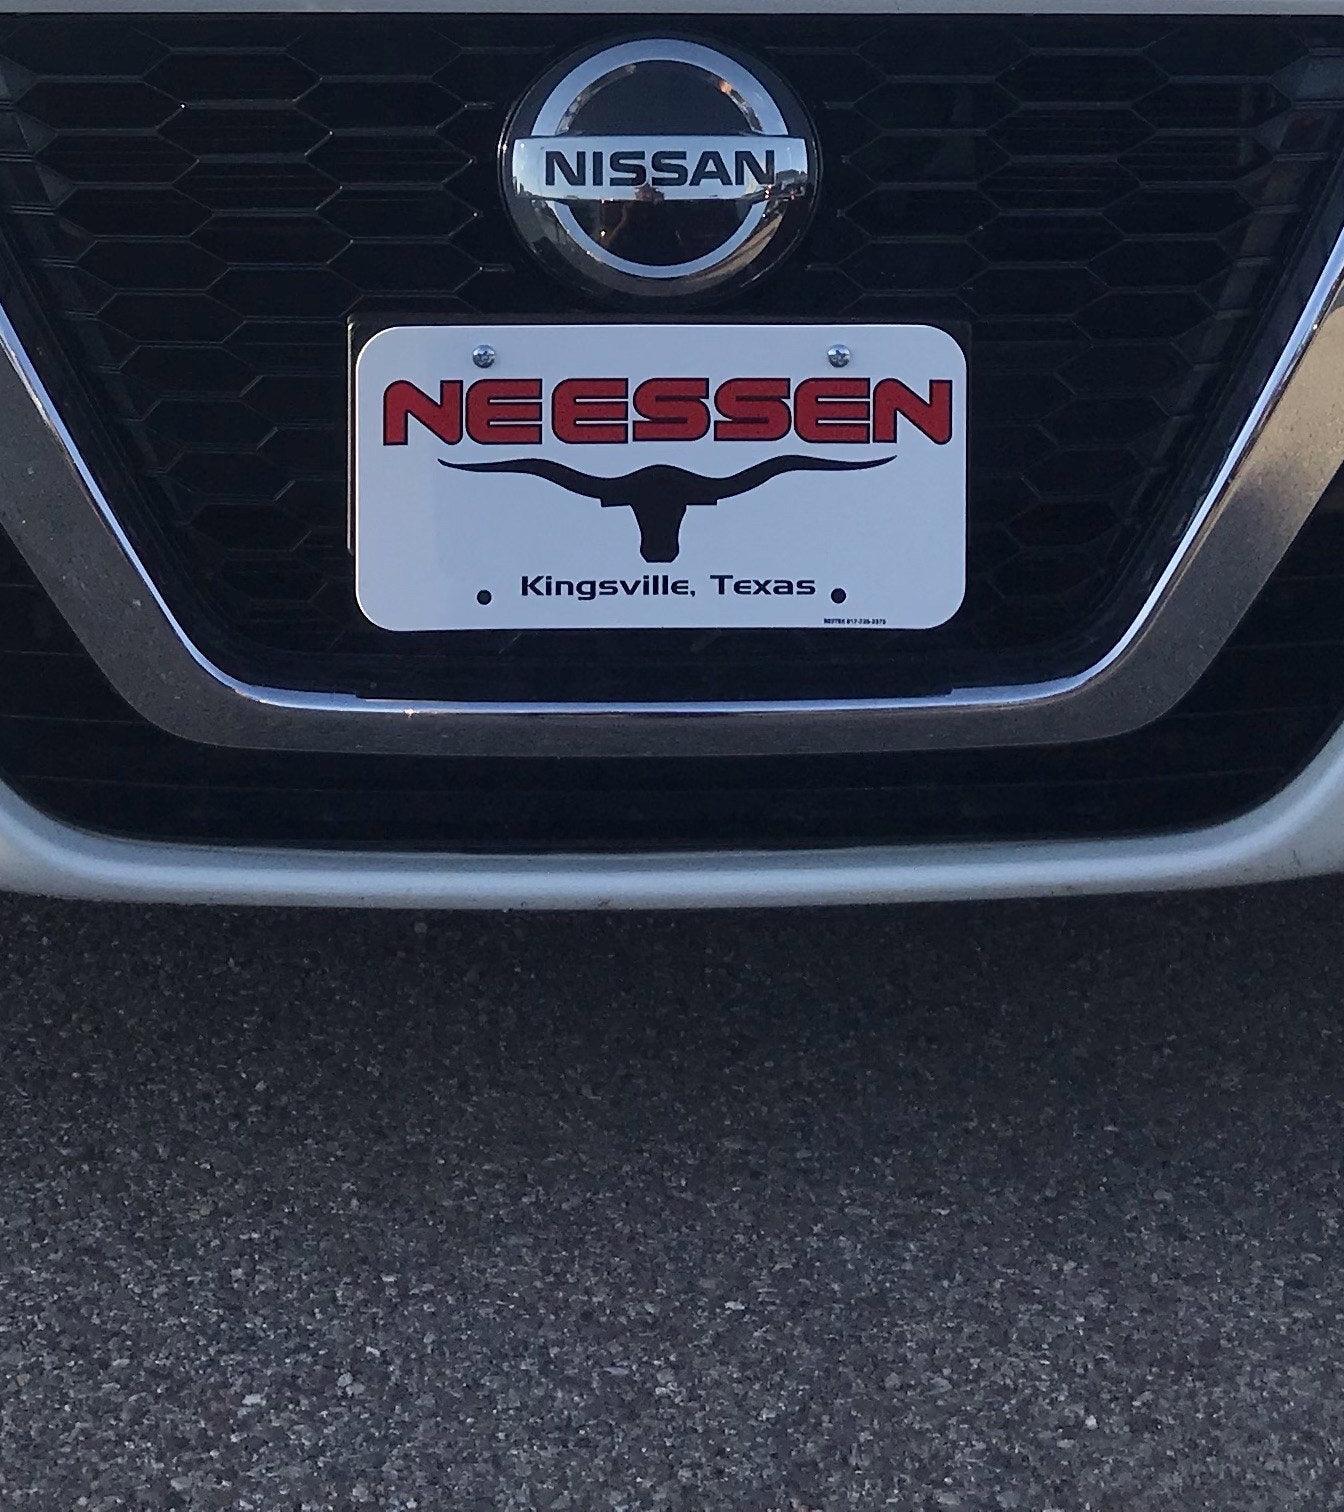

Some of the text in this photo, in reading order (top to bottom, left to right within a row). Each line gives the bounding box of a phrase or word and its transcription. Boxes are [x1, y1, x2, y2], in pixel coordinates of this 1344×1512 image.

[544, 149, 775, 187] NISSAN
[383, 377, 953, 446] NEESSEN
[521, 574, 816, 601] Kingsville, Texas
